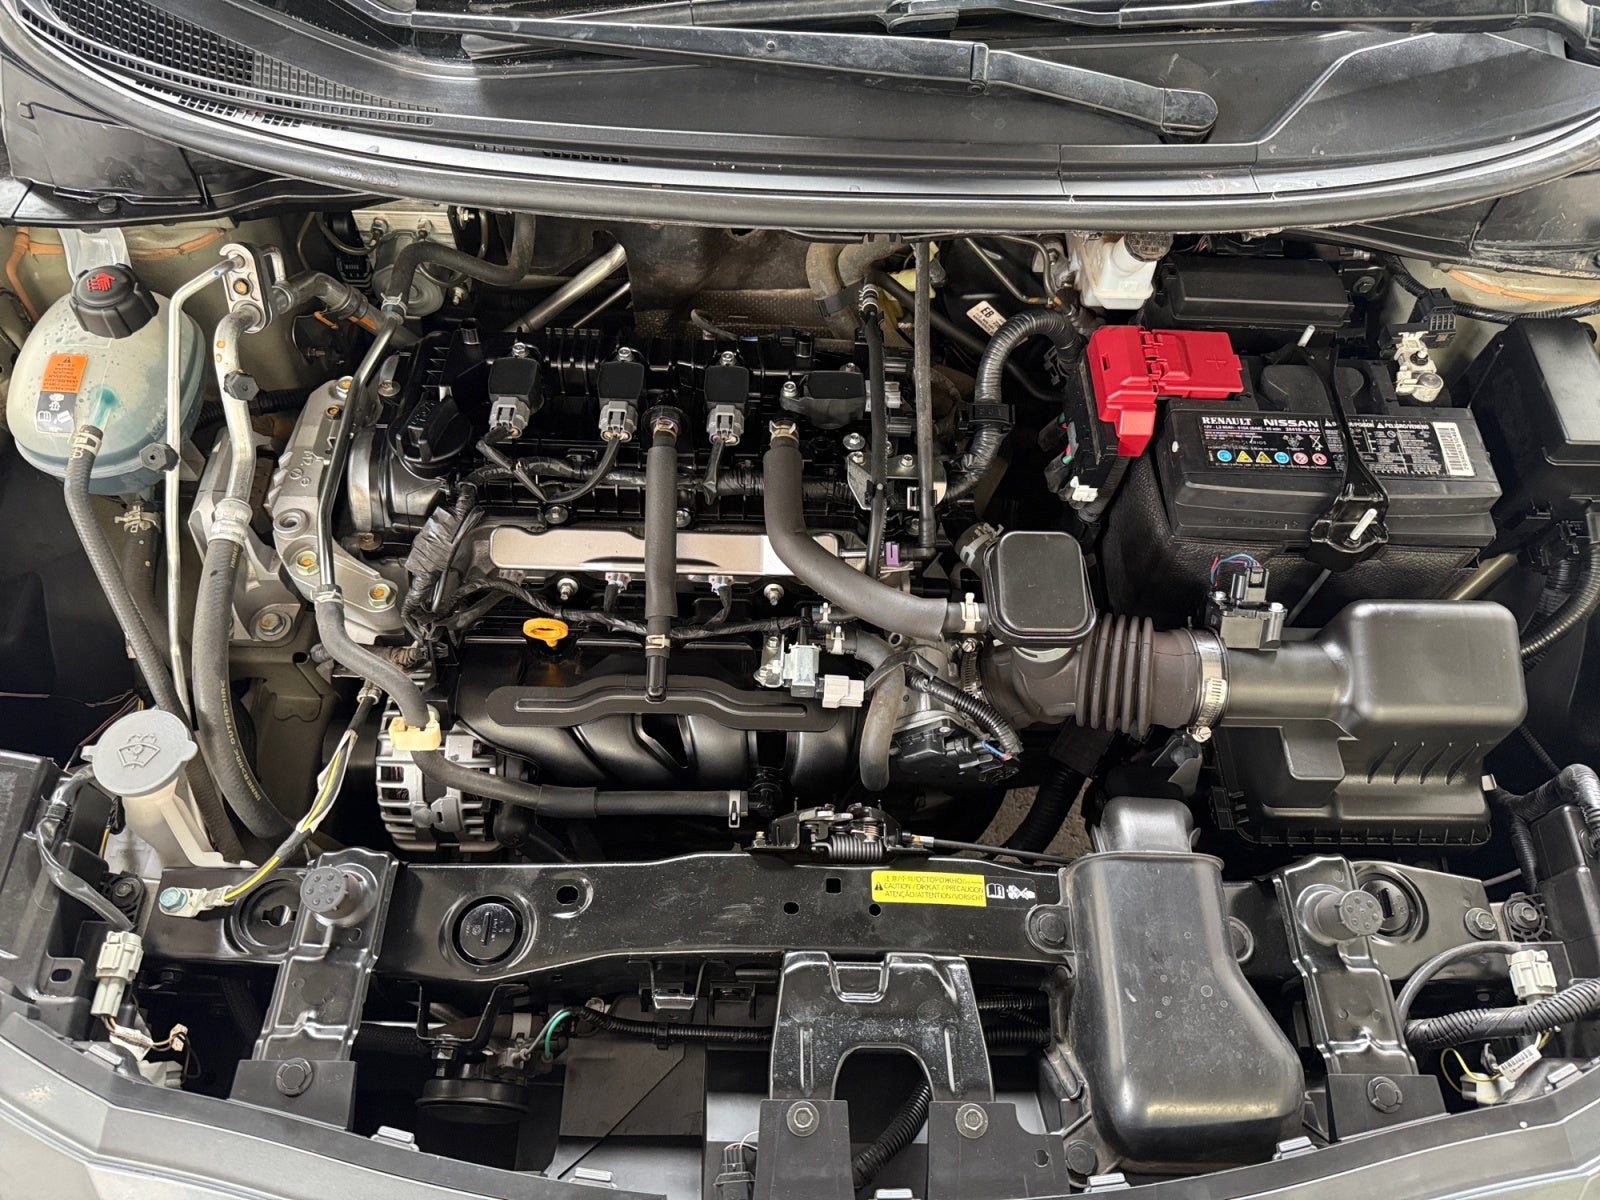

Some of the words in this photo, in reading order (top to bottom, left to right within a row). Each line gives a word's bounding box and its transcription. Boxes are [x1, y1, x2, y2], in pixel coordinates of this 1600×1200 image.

[980, 306, 995, 318] EB
[1201, 416, 1252, 426] RENAULT
[1263, 418, 1319, 428] NISSAN
[884, 882, 911, 890] CAUTION
